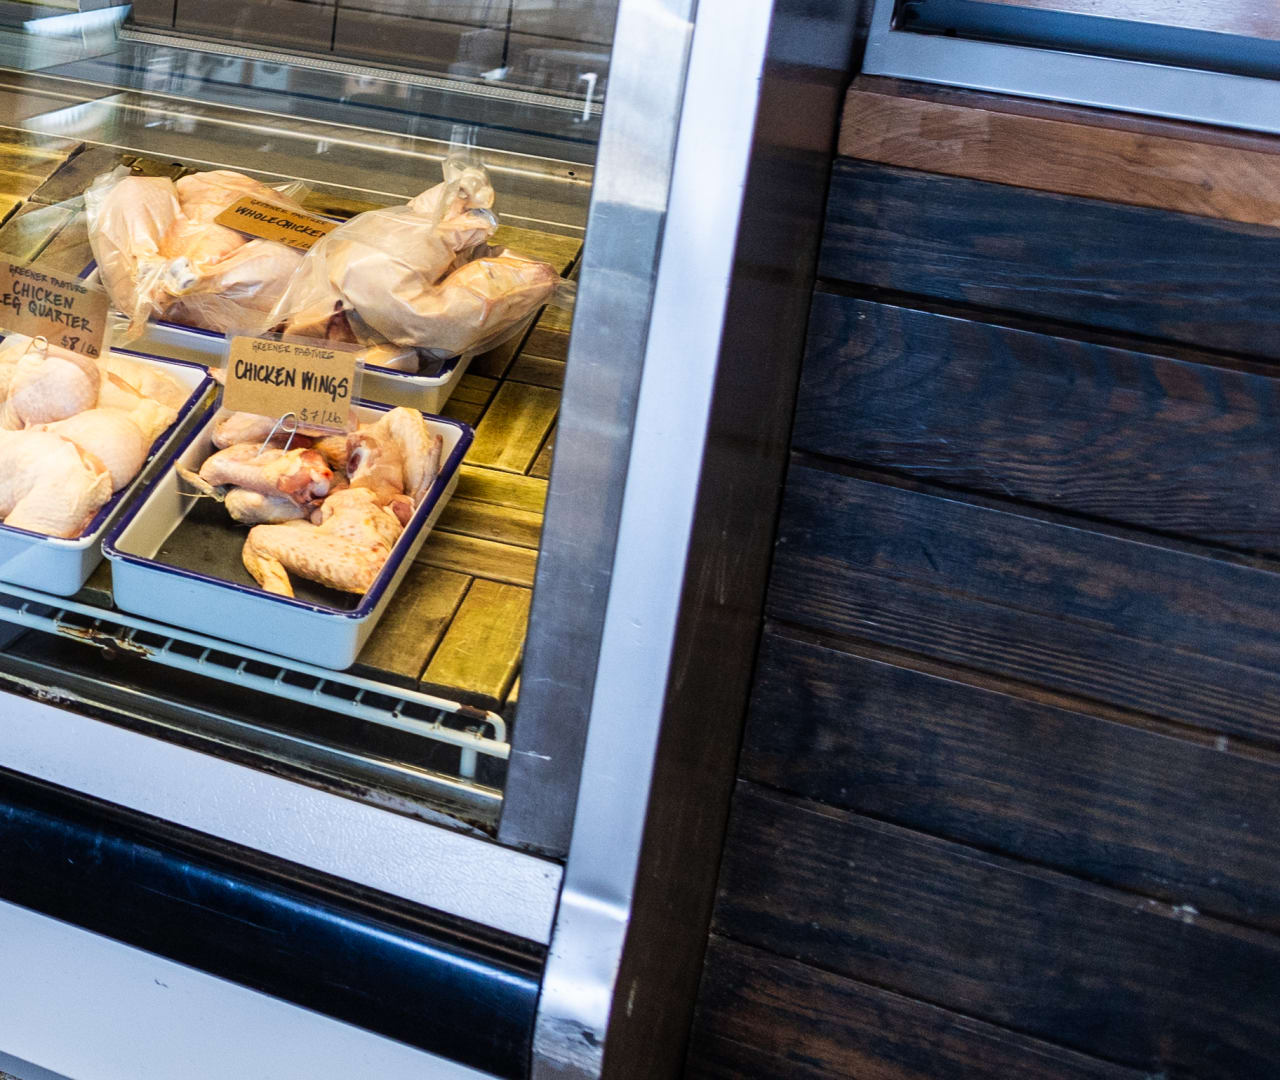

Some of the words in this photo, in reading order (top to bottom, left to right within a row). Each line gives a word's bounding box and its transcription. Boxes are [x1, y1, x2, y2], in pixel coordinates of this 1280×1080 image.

[9, 264, 48, 282] GREENER
[12, 280, 74, 309] CHICKEN
[28, 300, 93, 333] QUARTER
[252, 340, 291, 353] GREENER
[235, 360, 296, 388] CHICKEN
[301, 371, 348, 402] WINGS
